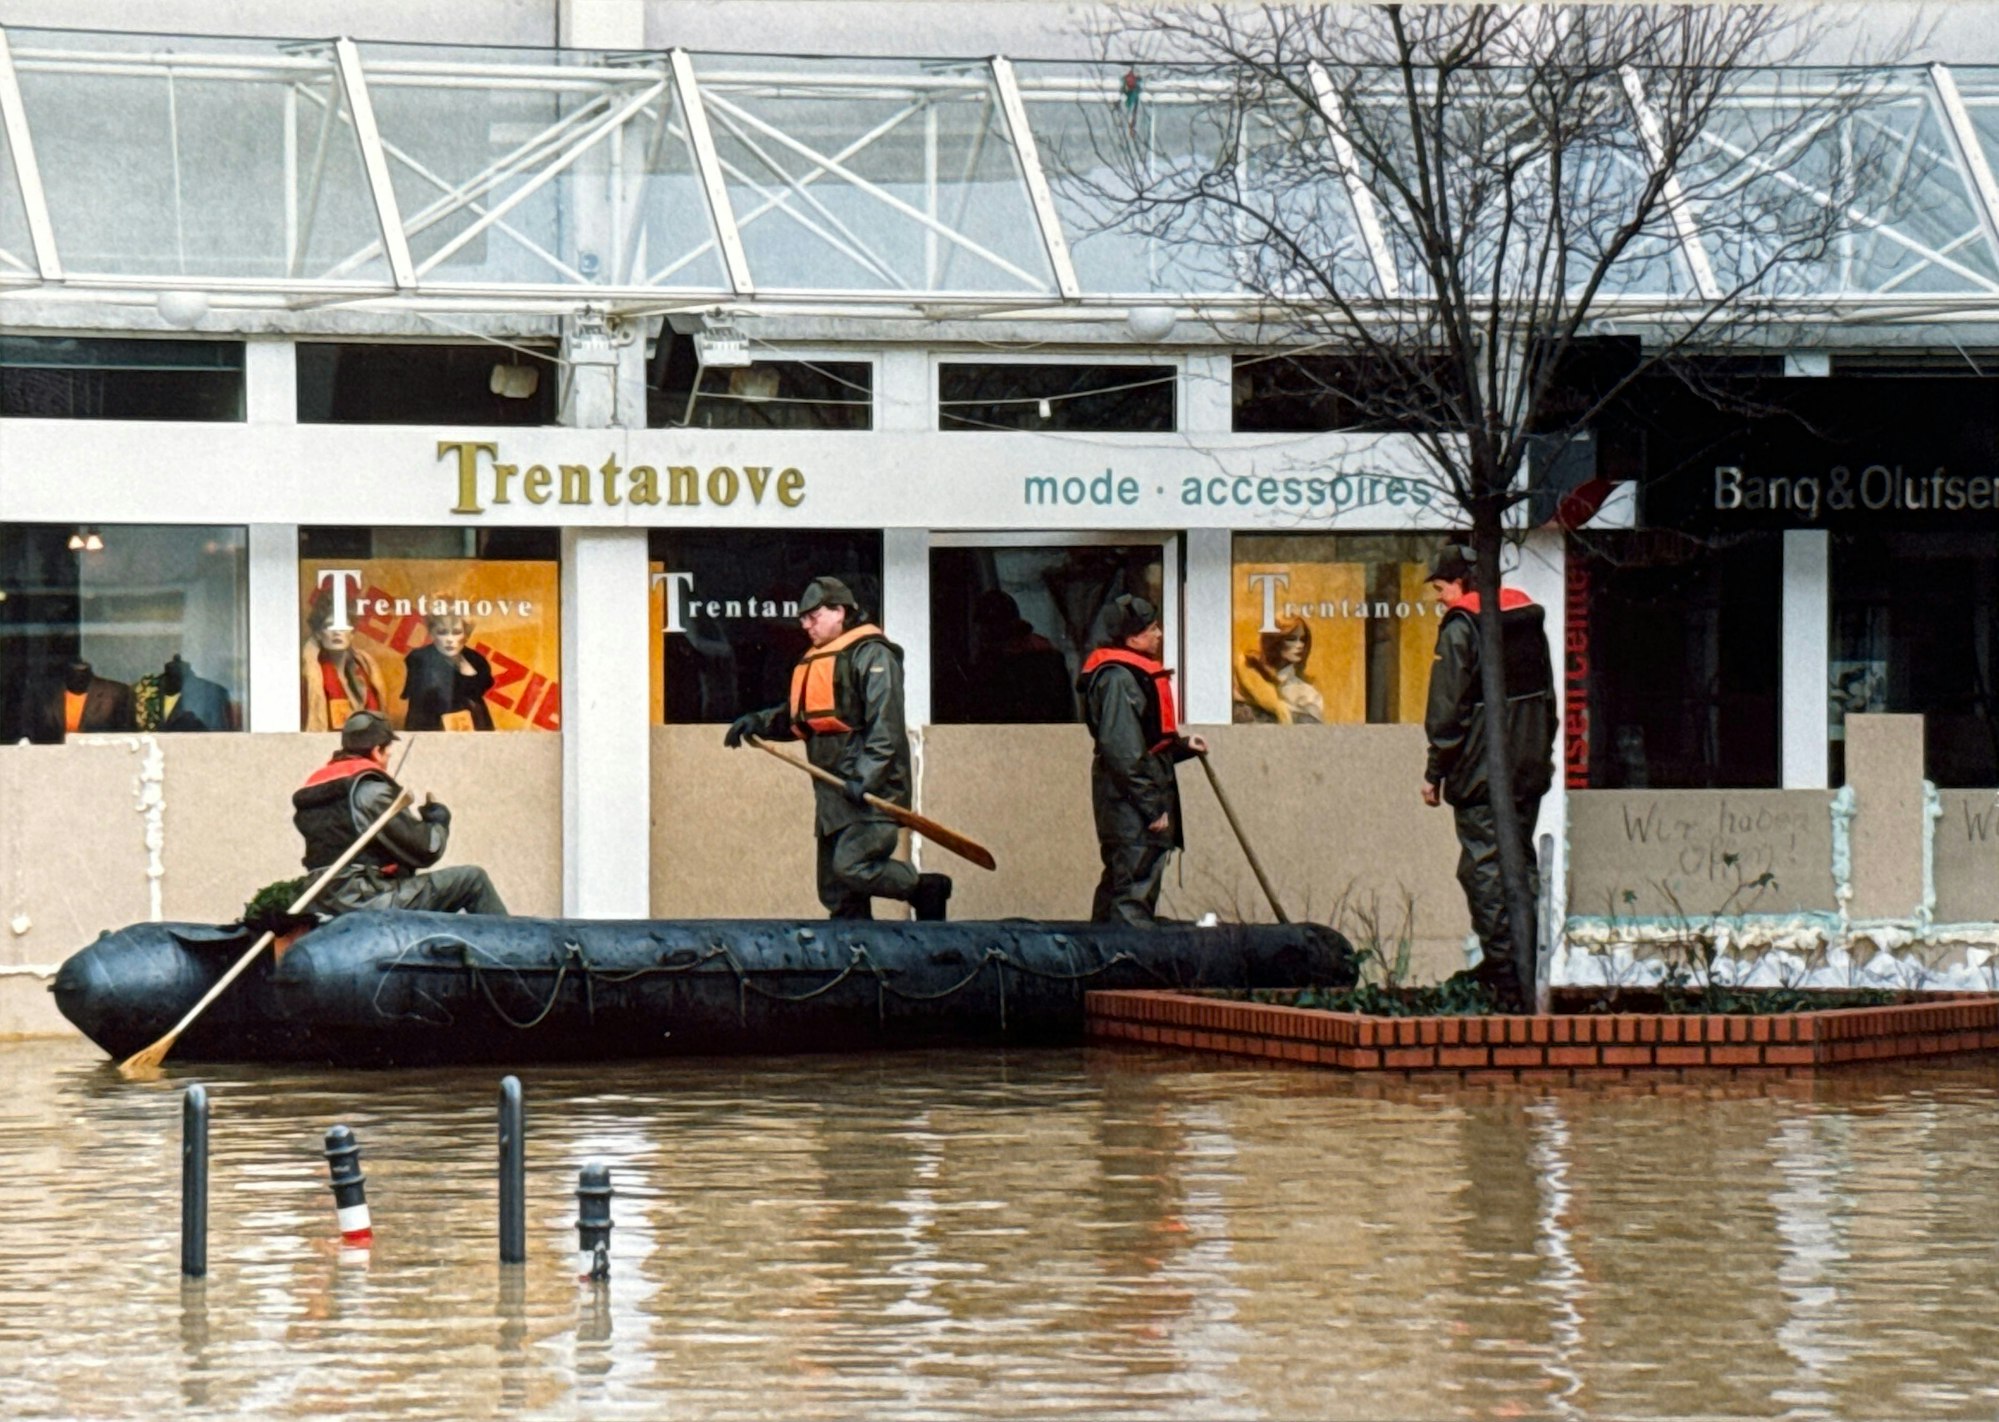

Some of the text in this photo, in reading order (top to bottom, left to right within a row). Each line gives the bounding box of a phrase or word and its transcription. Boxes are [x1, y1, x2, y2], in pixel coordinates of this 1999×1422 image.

[437, 440, 806, 514] Trentanove
[1024, 468, 1432, 506] mode accessoires
[1714, 465, 1821, 521] Bang
[317, 569, 533, 631] Trentanove
[1248, 572, 1447, 634] Trentanove
